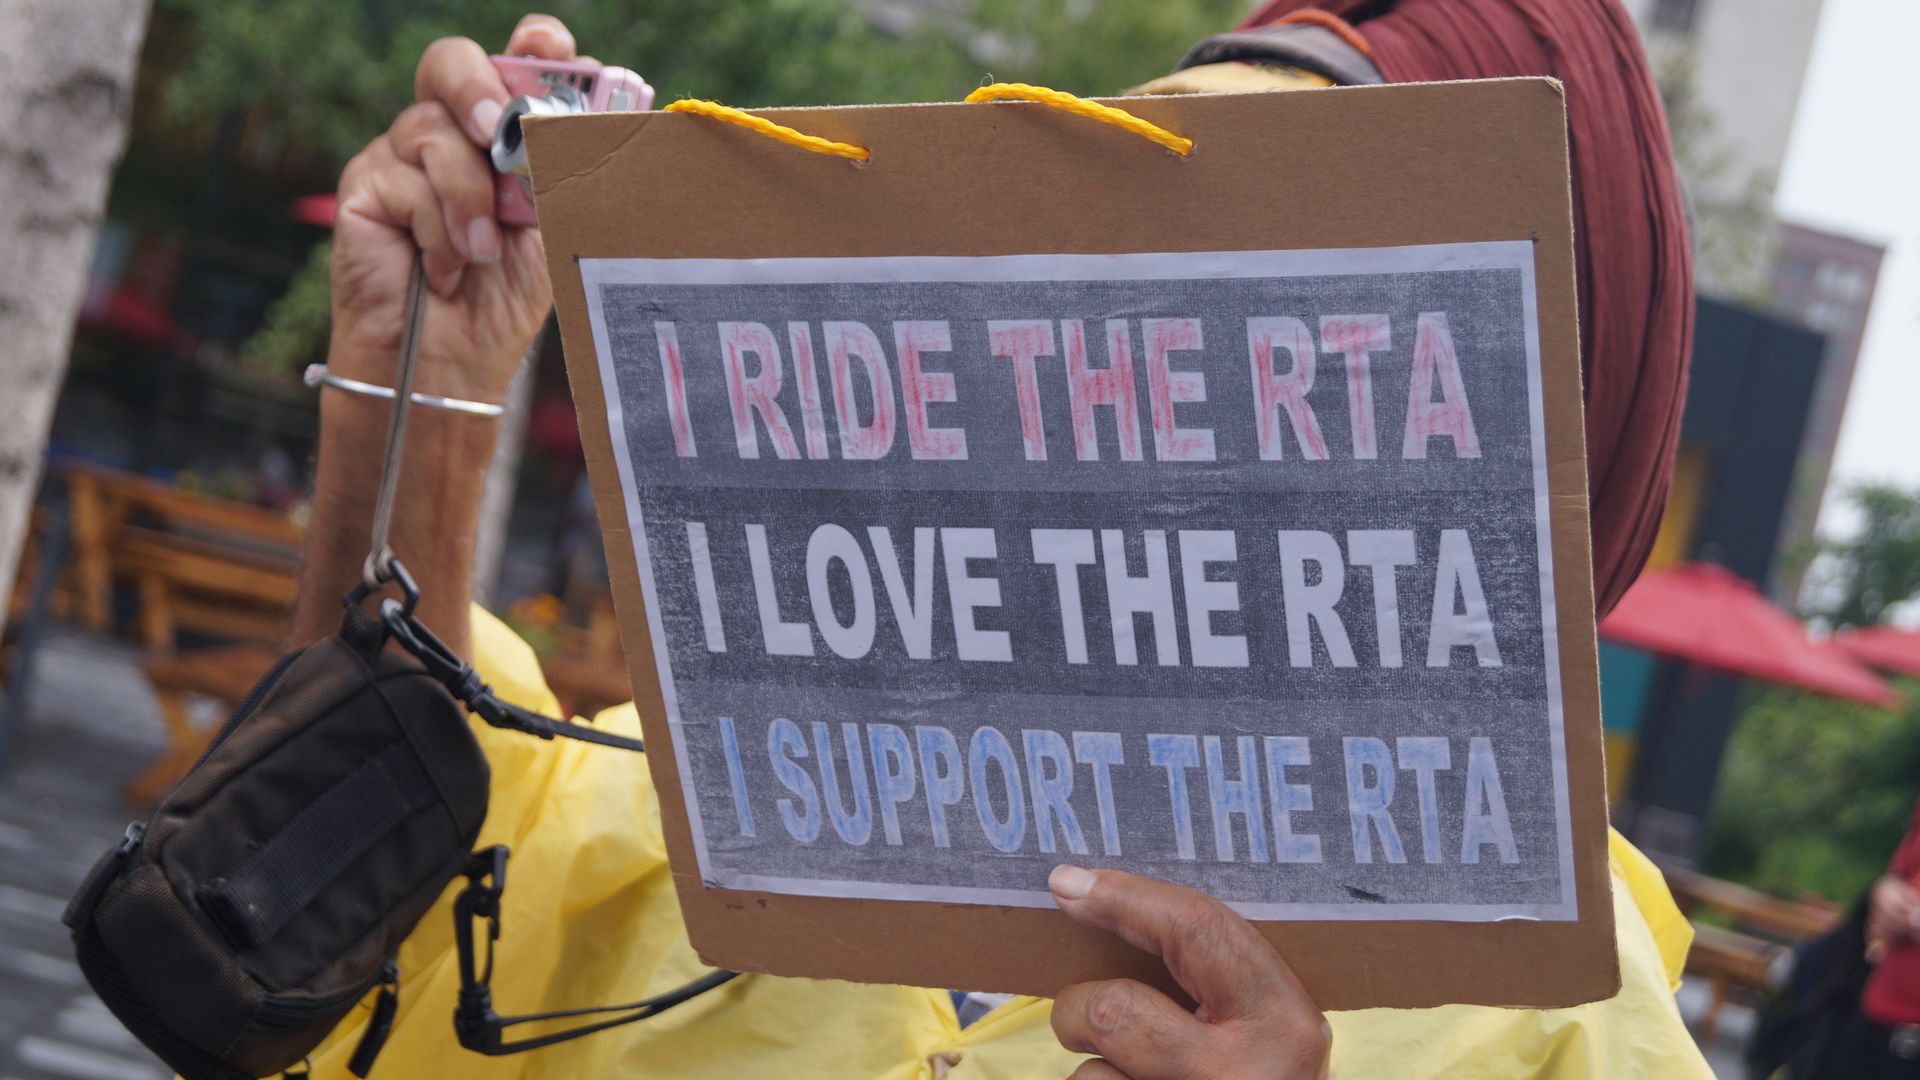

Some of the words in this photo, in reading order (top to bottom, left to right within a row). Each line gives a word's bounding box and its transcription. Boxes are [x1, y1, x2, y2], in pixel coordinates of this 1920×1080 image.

[655, 321, 697, 457] I
[717, 320, 968, 460] RIDE
[987, 318, 1216, 461] THE
[1246, 311, 1483, 460] RTA
[686, 522, 727, 653] I
[744, 523, 1013, 662] LOVE
[1031, 529, 1249, 668] THE
[1278, 529, 1503, 668] RTA
[718, 717, 756, 838] I
[767, 718, 1123, 857] SUPPORT
[1148, 734, 1323, 864] THE
[1343, 736, 1520, 864] RTA
